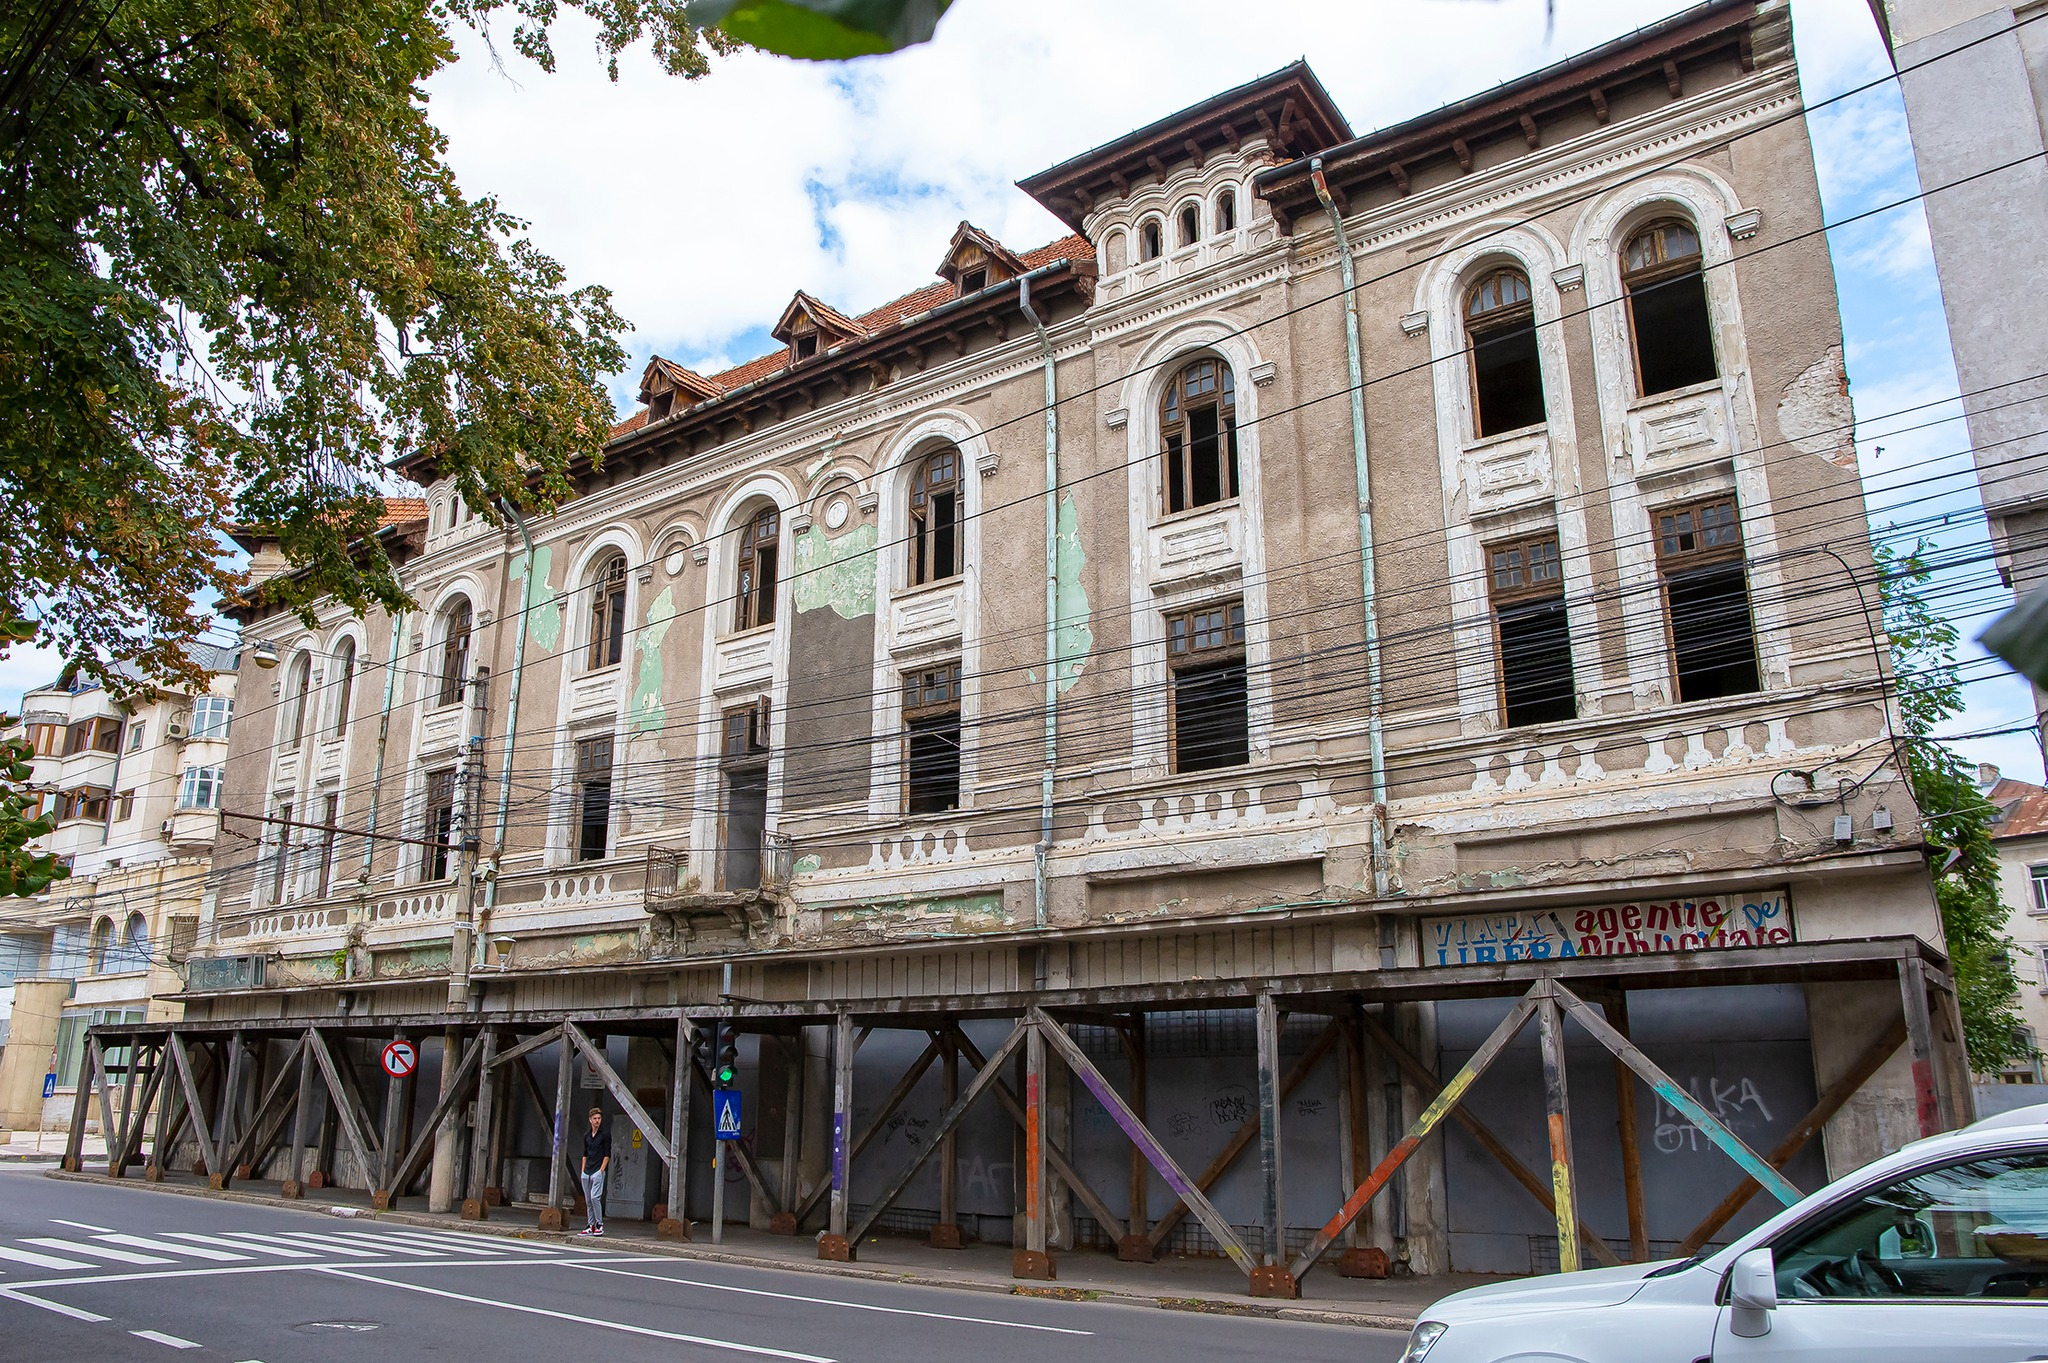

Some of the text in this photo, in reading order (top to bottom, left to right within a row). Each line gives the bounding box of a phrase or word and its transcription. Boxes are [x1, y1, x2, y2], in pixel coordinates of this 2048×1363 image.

[1429, 913, 1547, 947] VIATA
[1574, 896, 1780, 940] agentie De
